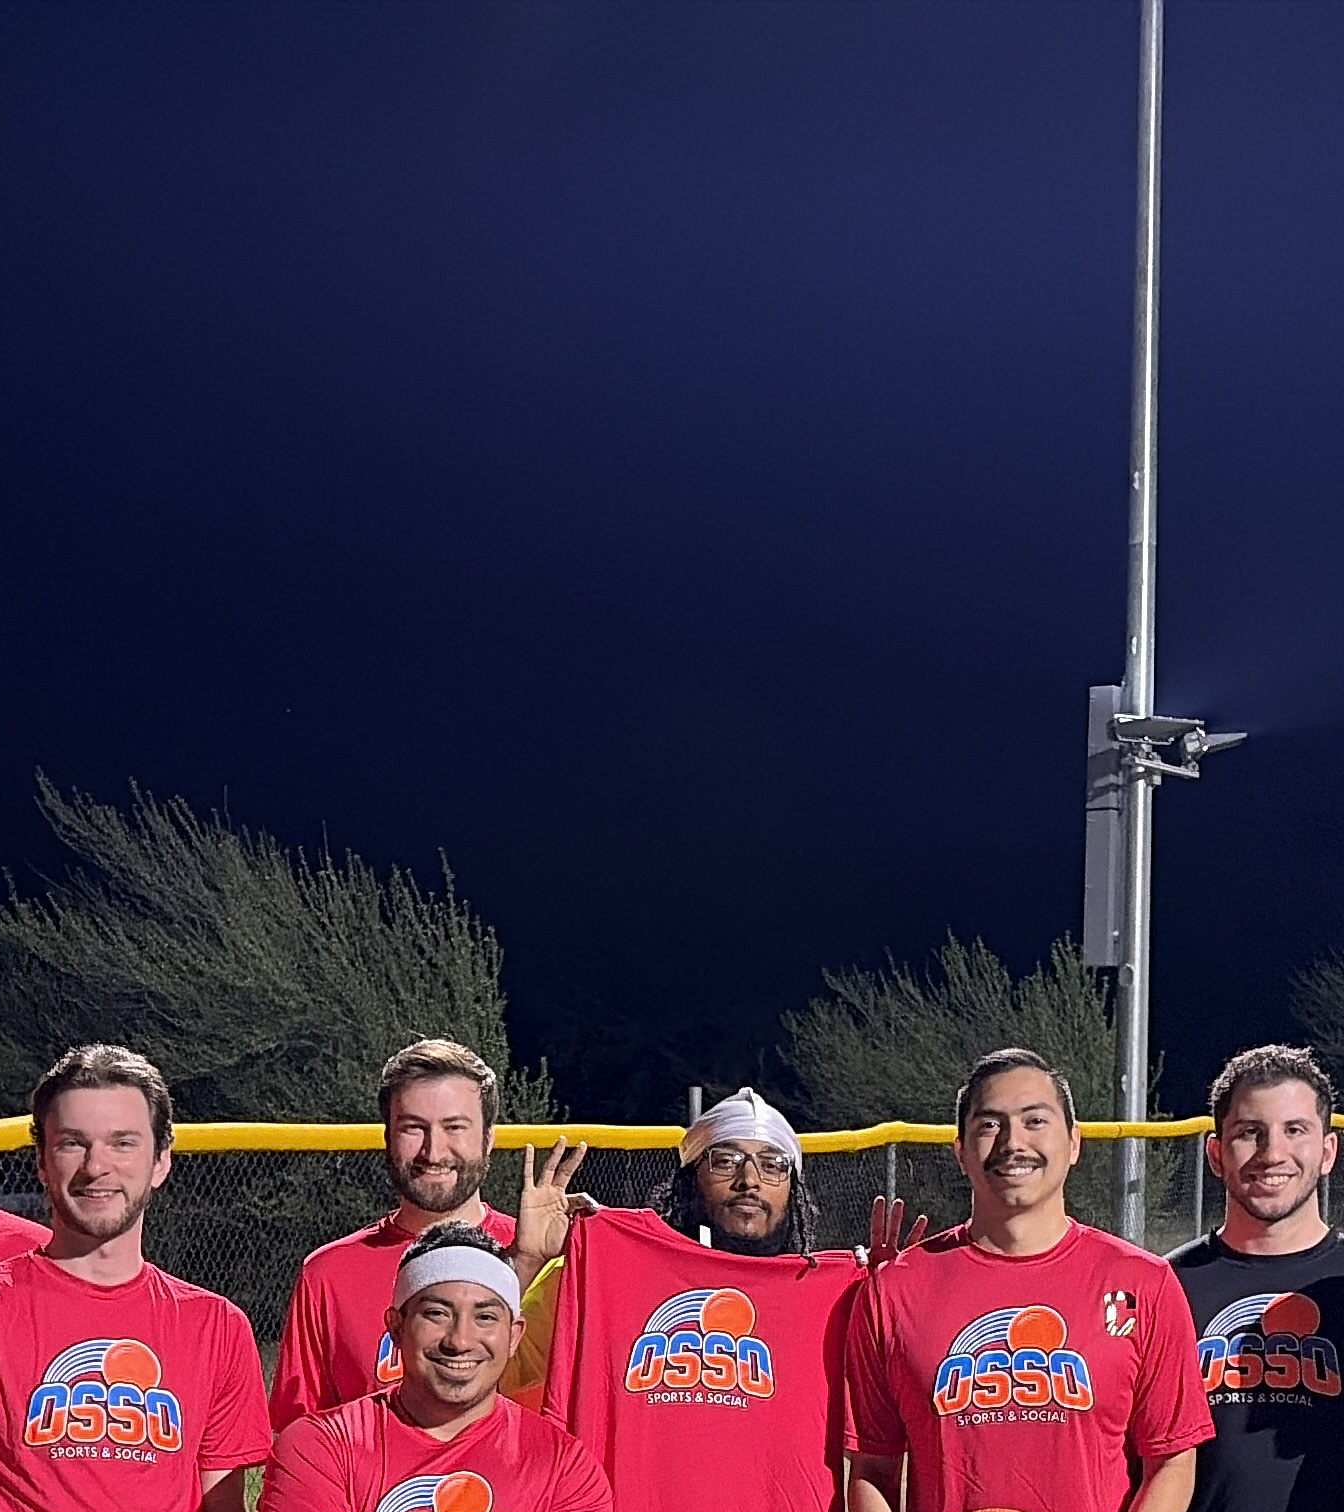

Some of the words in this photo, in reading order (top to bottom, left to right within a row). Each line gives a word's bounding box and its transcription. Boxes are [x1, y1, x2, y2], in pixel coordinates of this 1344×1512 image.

[624, 1330, 775, 1398] OSSO
[933, 1349, 1094, 1415] OSSO
[1197, 1333, 1342, 1397] OSSO
[24, 1381, 183, 1452] OSSO
[647, 1391, 692, 1403] SPORTS
[694, 1391, 704, 1403] &
[706, 1393, 748, 1408] SOCIAL
[957, 1411, 1004, 1426] SPORTS
[1007, 1411, 1017, 1422] &
[1020, 1410, 1067, 1423] SOCIAL
[1208, 1393, 1254, 1406] SPORTS
[1257, 1395, 1267, 1403] &
[1269, 1393, 1313, 1407] SOCIAL
[50, 1446, 97, 1459] SPORTS
[101, 1447, 111, 1458] &
[114, 1448, 158, 1464] SOCIAL
